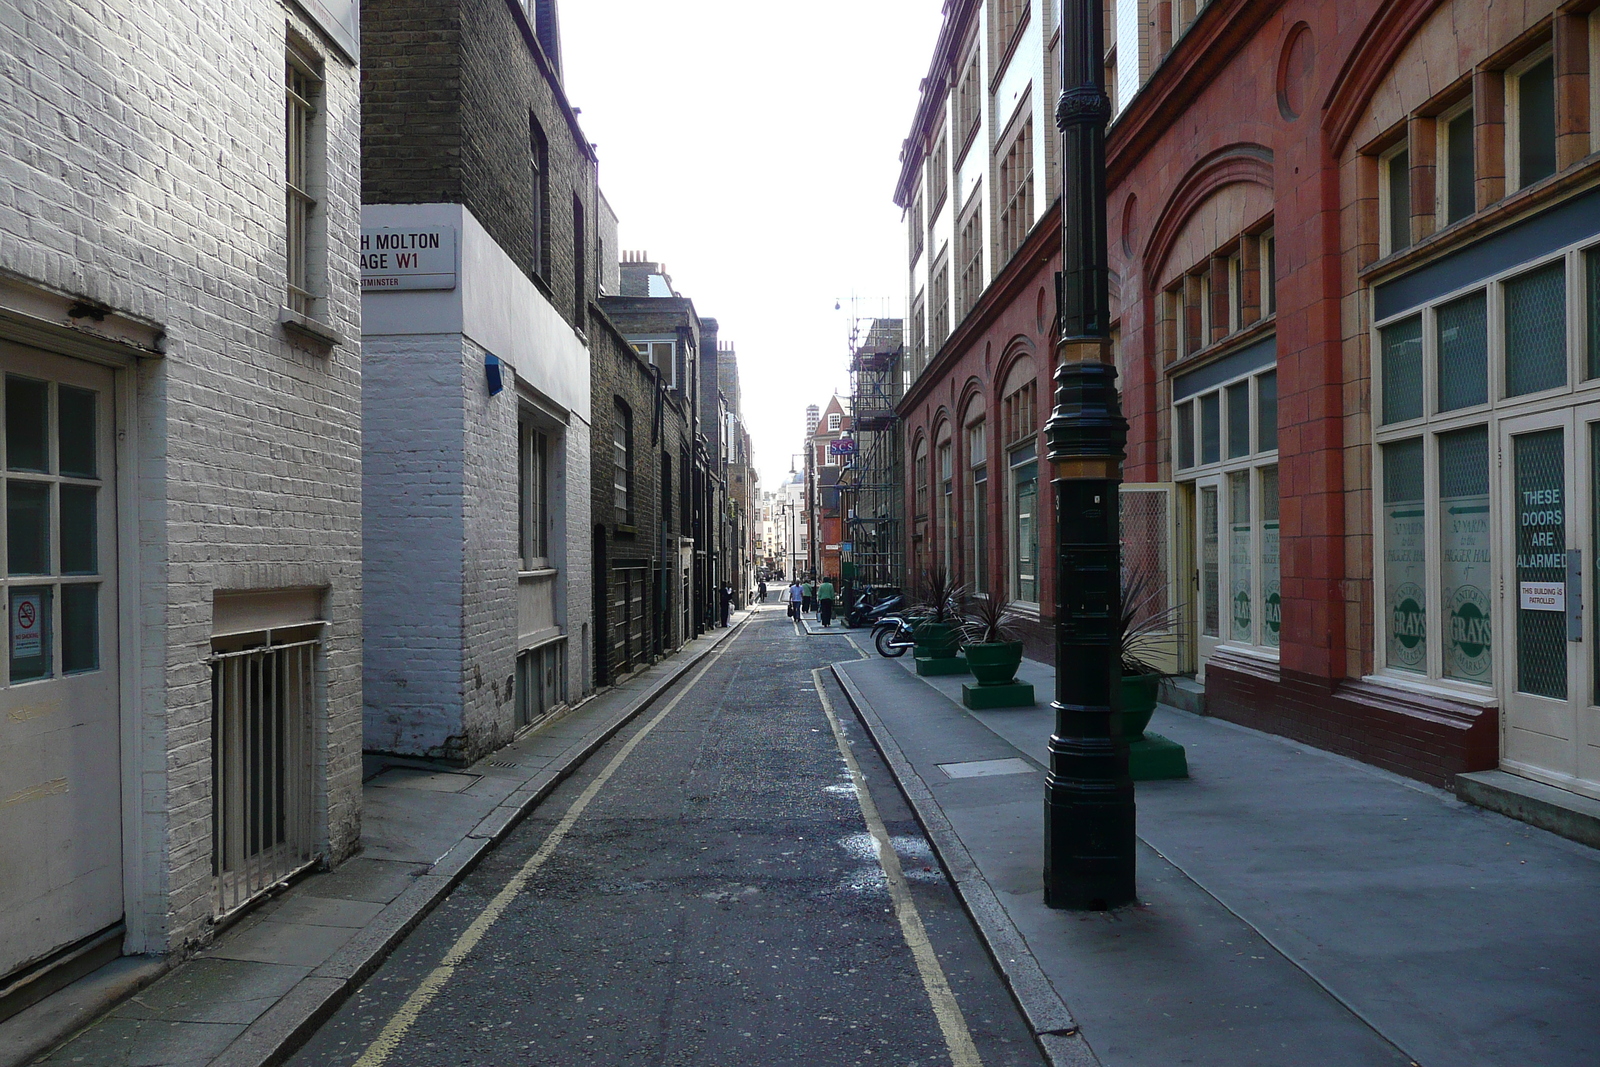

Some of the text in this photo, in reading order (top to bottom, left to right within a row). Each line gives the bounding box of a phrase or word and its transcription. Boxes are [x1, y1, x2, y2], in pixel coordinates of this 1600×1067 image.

[376, 233, 440, 250] MOLTON
[360, 252, 418, 269] AGE W1
[360, 278, 399, 287] STMINSTER
[1523, 489, 1560, 506] THESE
[1522, 510, 1563, 526] DOORS
[1531, 532, 1554, 547] ARE
[1516, 553, 1567, 568] ALARMED
[1522, 587, 1533, 595] THIS
[1533, 587, 1556, 596] BUILDING
[1529, 596, 1556, 605] PATROLLED
[1393, 611, 1426, 638] GRAYS
[1451, 616, 1491, 645] GRAYS
